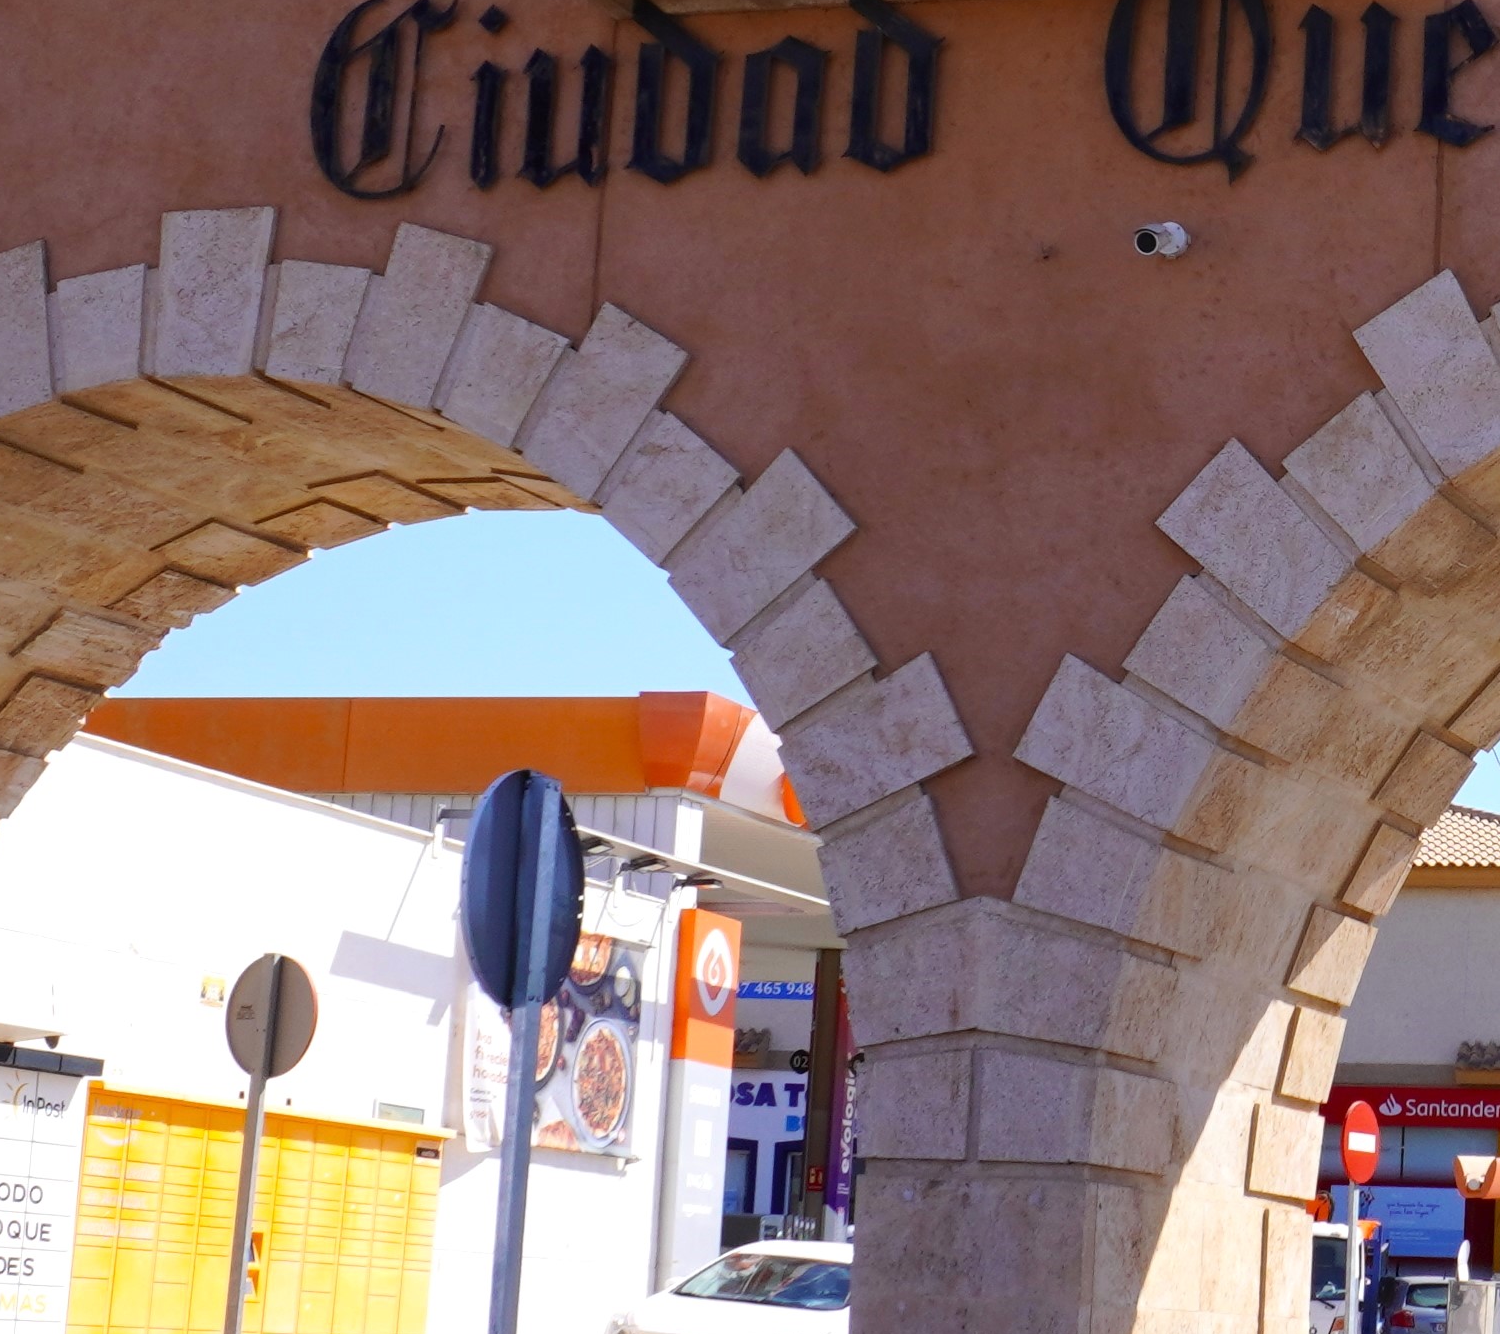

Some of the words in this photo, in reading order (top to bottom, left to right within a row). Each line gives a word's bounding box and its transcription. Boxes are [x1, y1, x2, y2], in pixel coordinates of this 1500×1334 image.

[754, 982, 781, 995] 465
[786, 983, 814, 995] 948
[793, 1057, 808, 1068] 02
[22, 1094, 65, 1119] InPost
[6, 1219, 53, 1243] QUE
